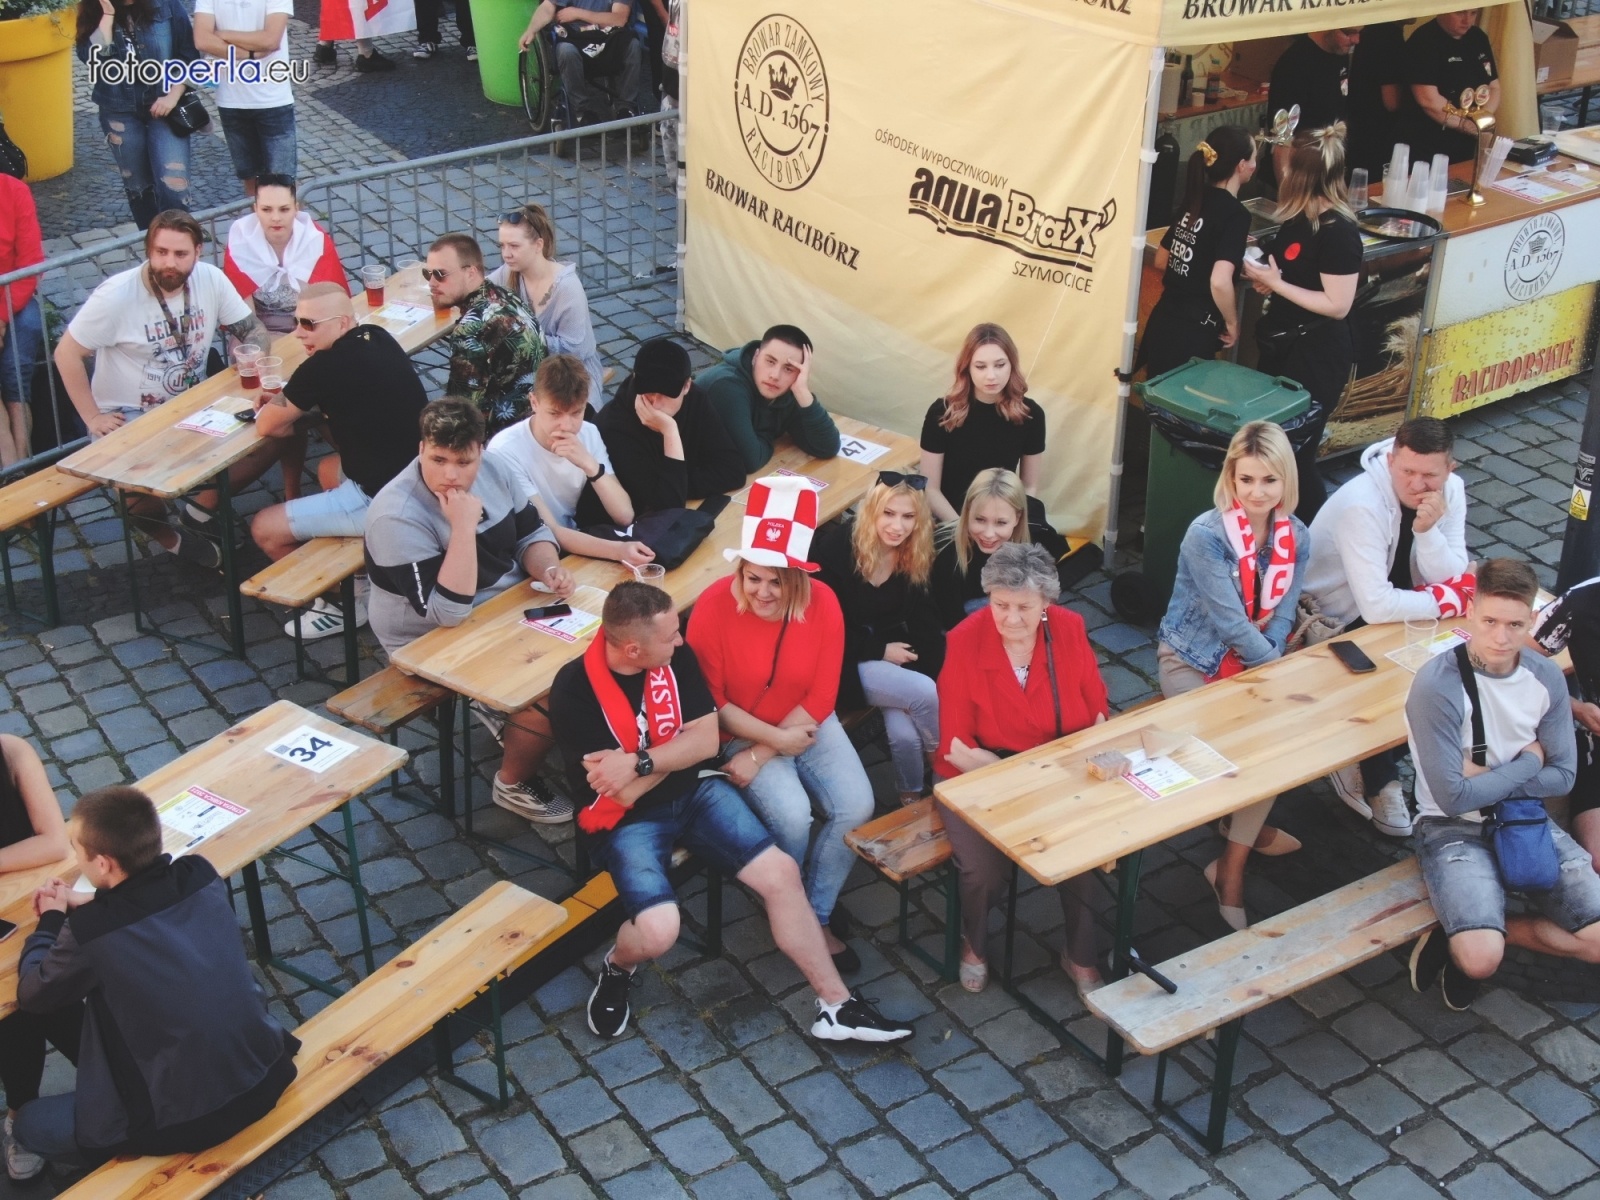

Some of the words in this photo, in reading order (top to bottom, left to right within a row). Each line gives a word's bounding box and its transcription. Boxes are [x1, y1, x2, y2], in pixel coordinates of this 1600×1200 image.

[743, 22, 781, 75] BROWAR
[785, 24, 824, 102] ZAMKOWY
[781, 103, 820, 150] 1567
[745, 127, 811, 186] RACIBÓRZ
[875, 128, 920, 158] OŚRODEK
[921, 146, 1009, 190] WYPOCZYNKOWY
[705, 167, 769, 223] BROWAR
[771, 207, 861, 271] RACIBÓRZ
[1170, 238, 1194, 263] ZERO
[1012, 260, 1094, 294] SZYMOCICE
[841, 440, 867, 457] 47
[289, 736, 333, 762] 34
